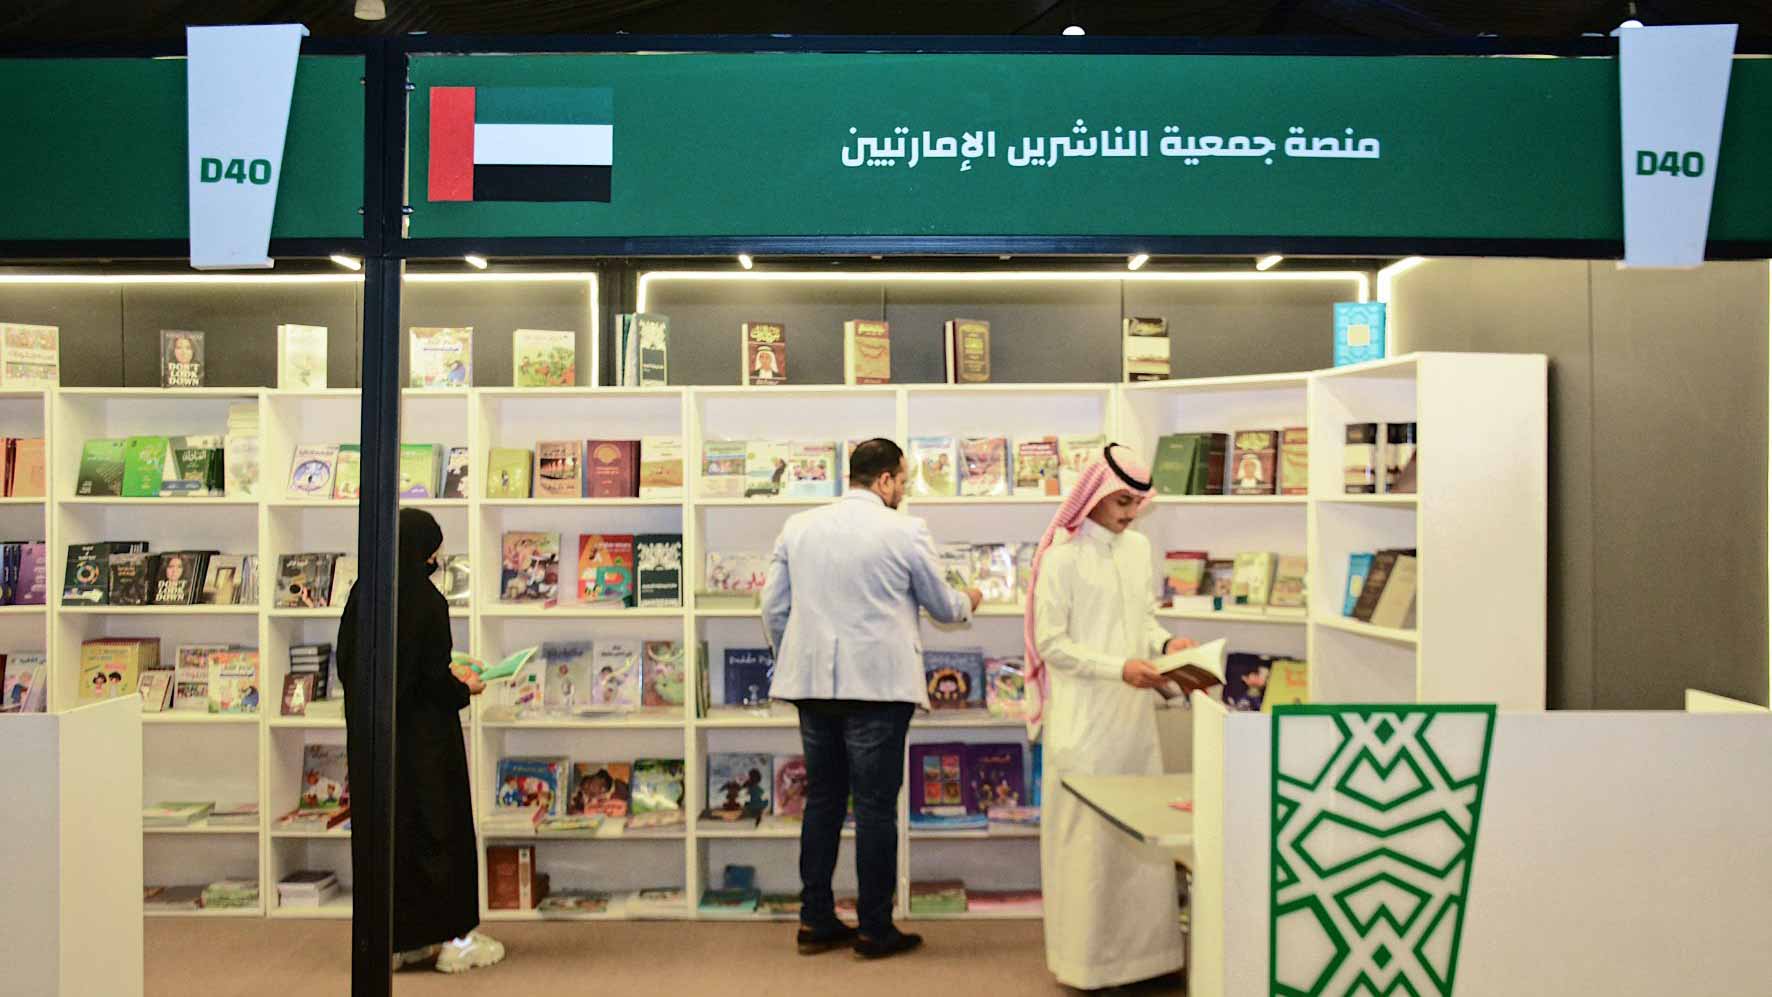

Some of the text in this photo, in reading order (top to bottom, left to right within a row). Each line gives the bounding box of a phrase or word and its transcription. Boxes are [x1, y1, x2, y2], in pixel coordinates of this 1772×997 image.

[1007, 118, 1149, 168] الناشرين
[1159, 125, 1276, 166] جمعية
[1284, 126, 1380, 159] منصة
[200, 158, 272, 185] D40
[1636, 150, 1704, 177] D40
[168, 378, 200, 386] DOWN
[169, 370, 199, 378] LOOK
[155, 593, 185, 602] DOWN
